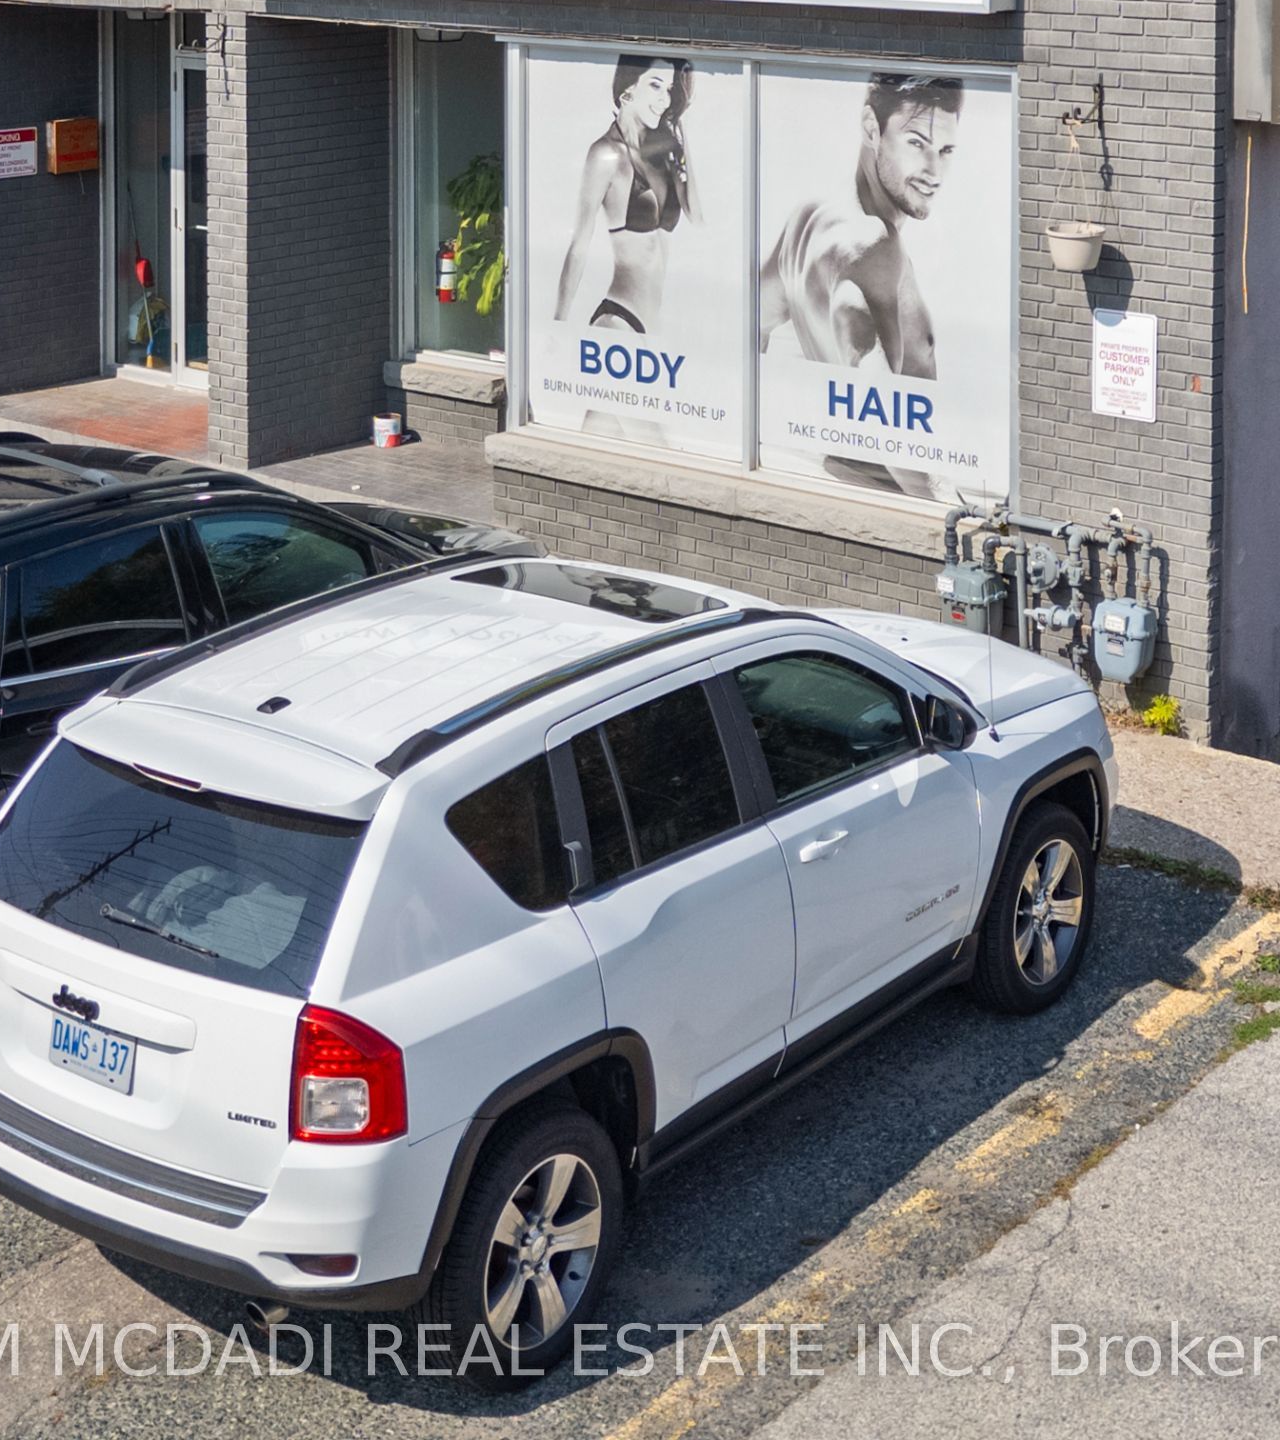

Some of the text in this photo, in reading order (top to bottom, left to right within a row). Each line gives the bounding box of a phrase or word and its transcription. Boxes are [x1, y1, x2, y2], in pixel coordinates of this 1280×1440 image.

[580, 339, 686, 389] BODY
[1099, 350, 1150, 365] CUSTOMER
[1104, 362, 1144, 376] PARKING
[543, 378, 726, 421] BURN UNWANTED FAT & TONE UP
[1112, 374, 1136, 387] ONLY
[828, 380, 934, 434] HAIR
[787, 422, 978, 468] TAKE CONTROL OF YOUR HAIR
[52, 984, 100, 1021] Jeep
